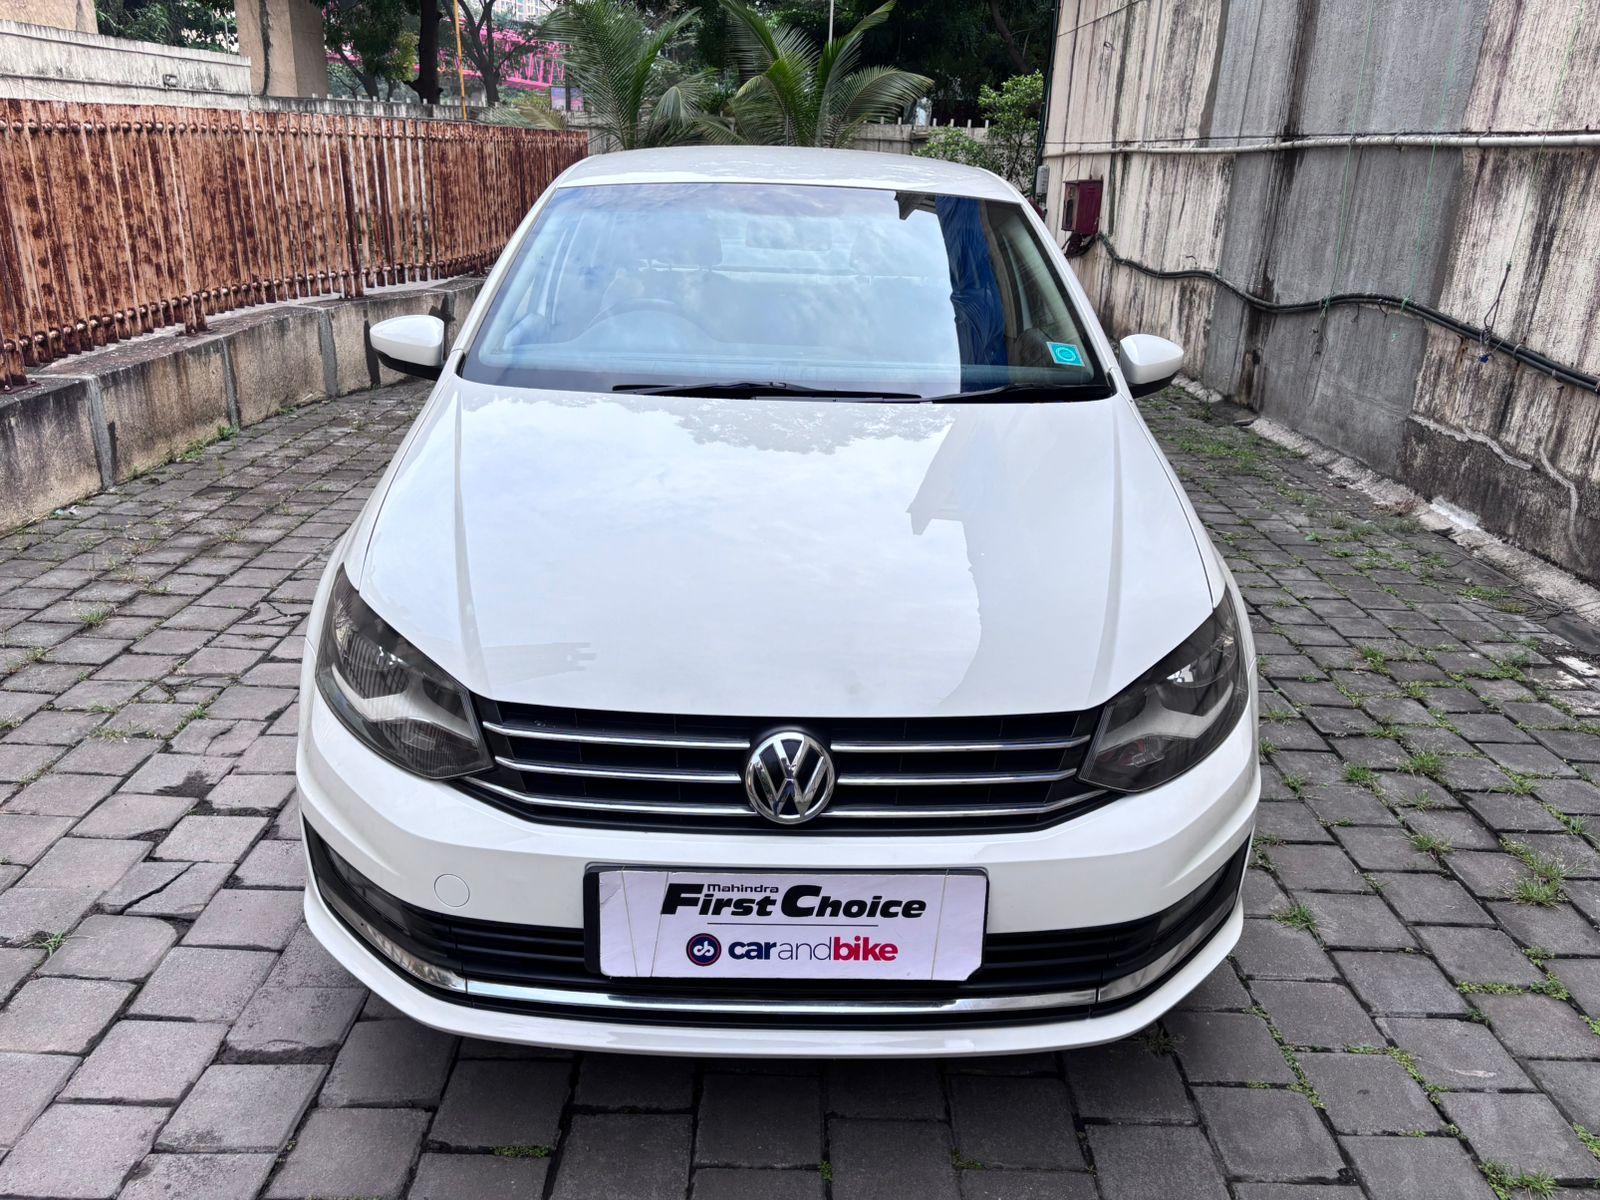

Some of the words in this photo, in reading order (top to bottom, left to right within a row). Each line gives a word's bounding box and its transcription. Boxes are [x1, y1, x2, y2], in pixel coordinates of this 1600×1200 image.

[748, 732, 832, 820] VW
[660, 883, 777, 917] First
[780, 884, 927, 919] Choice
[707, 883, 779, 894] Mahindra
